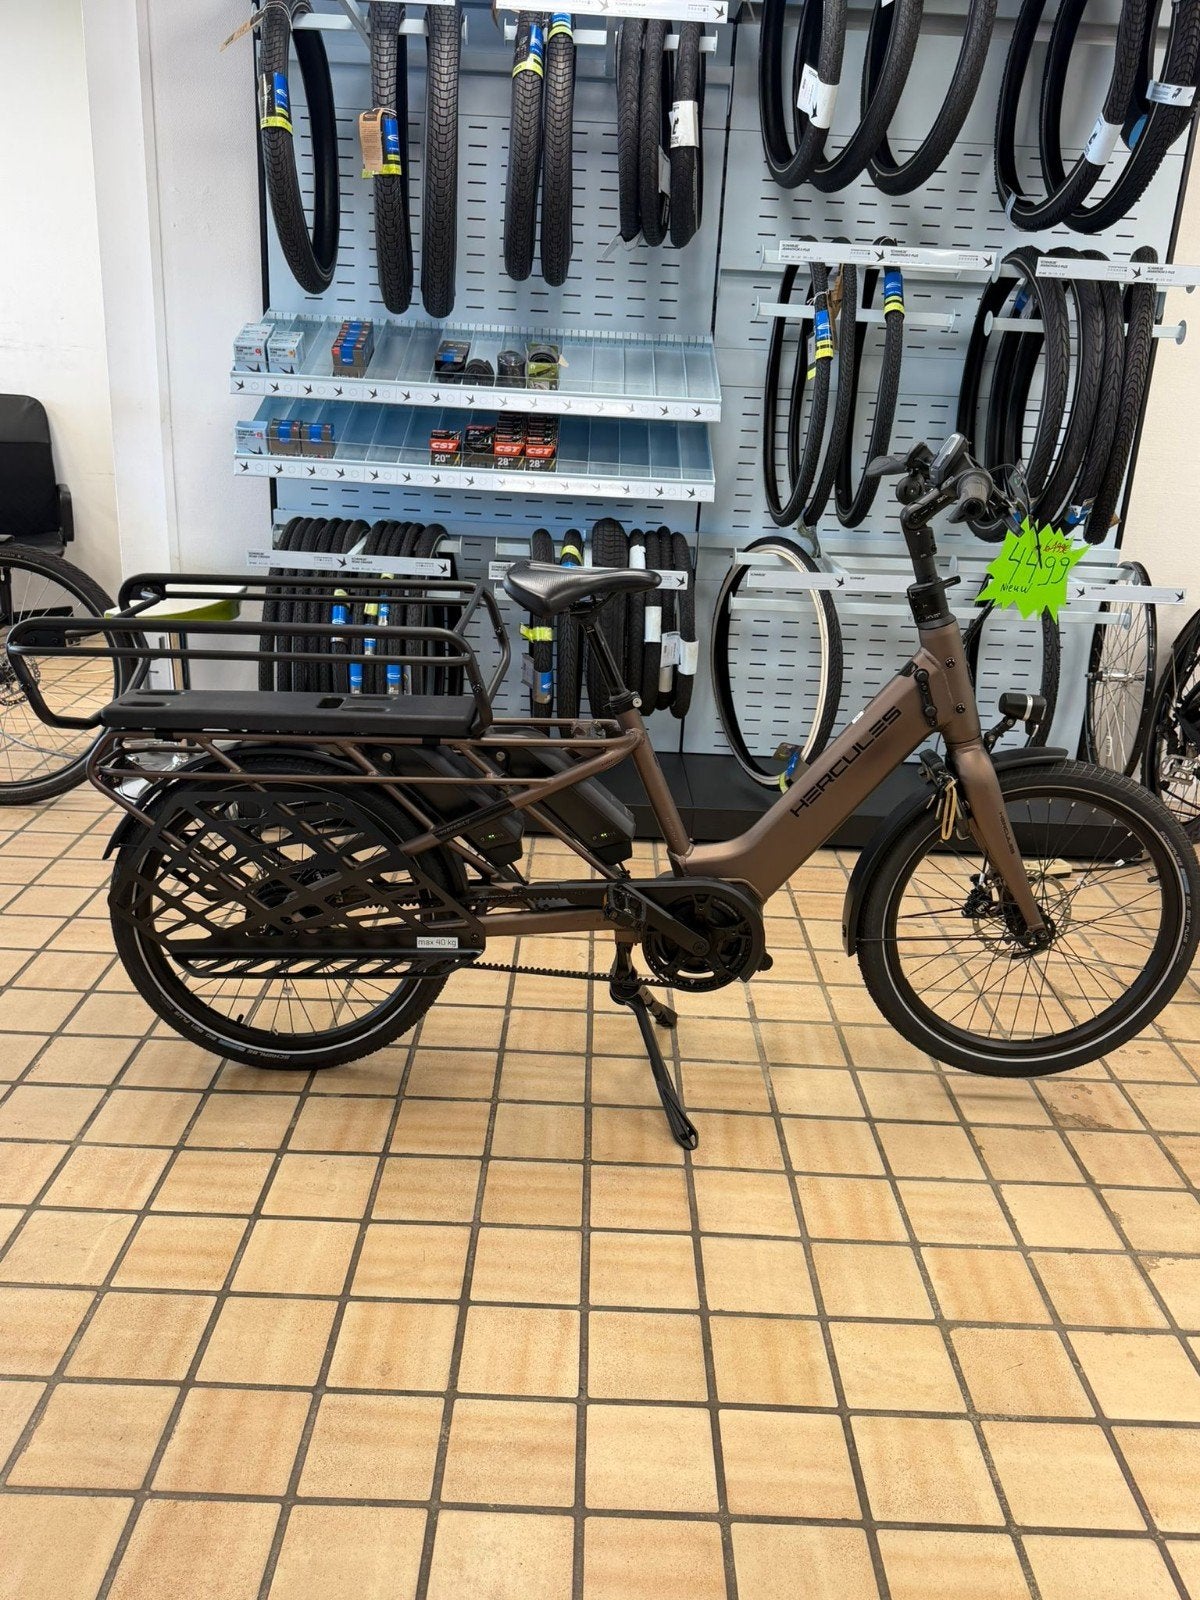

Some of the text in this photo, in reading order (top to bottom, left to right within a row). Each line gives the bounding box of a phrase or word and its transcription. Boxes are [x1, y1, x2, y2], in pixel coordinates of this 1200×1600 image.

[495, 445, 521, 453] CST
[526, 447, 552, 455] CST
[1008, 542, 1070, 586] 4499
[790, 705, 902, 818] HERCULES
[435, 938, 446, 946] 40
[447, 939, 457, 948] kg
